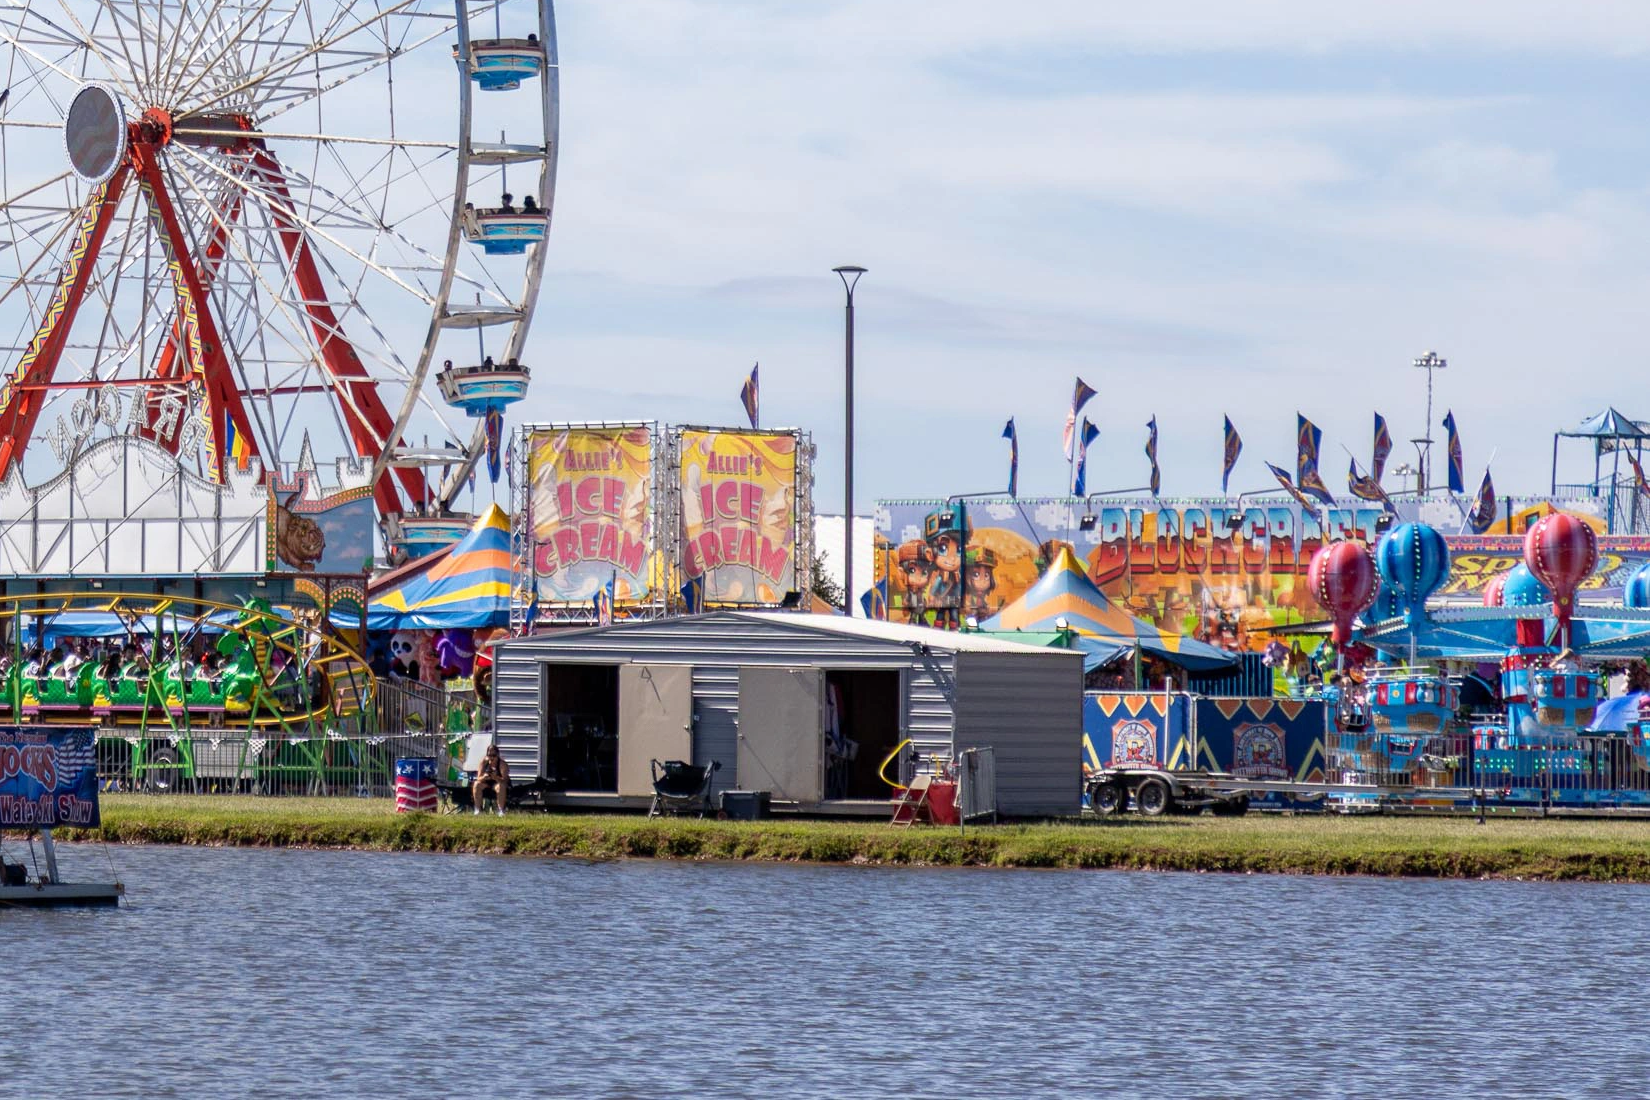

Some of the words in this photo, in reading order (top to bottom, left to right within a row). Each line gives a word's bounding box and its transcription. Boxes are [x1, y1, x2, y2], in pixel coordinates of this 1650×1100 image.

[563, 450, 624, 471] ALLIE'S
[706, 450, 763, 476] ALLIE'S
[556, 476, 626, 522] ICE
[700, 479, 765, 524] ICE
[534, 522, 646, 579] CREAM
[683, 525, 790, 585] CREAM
